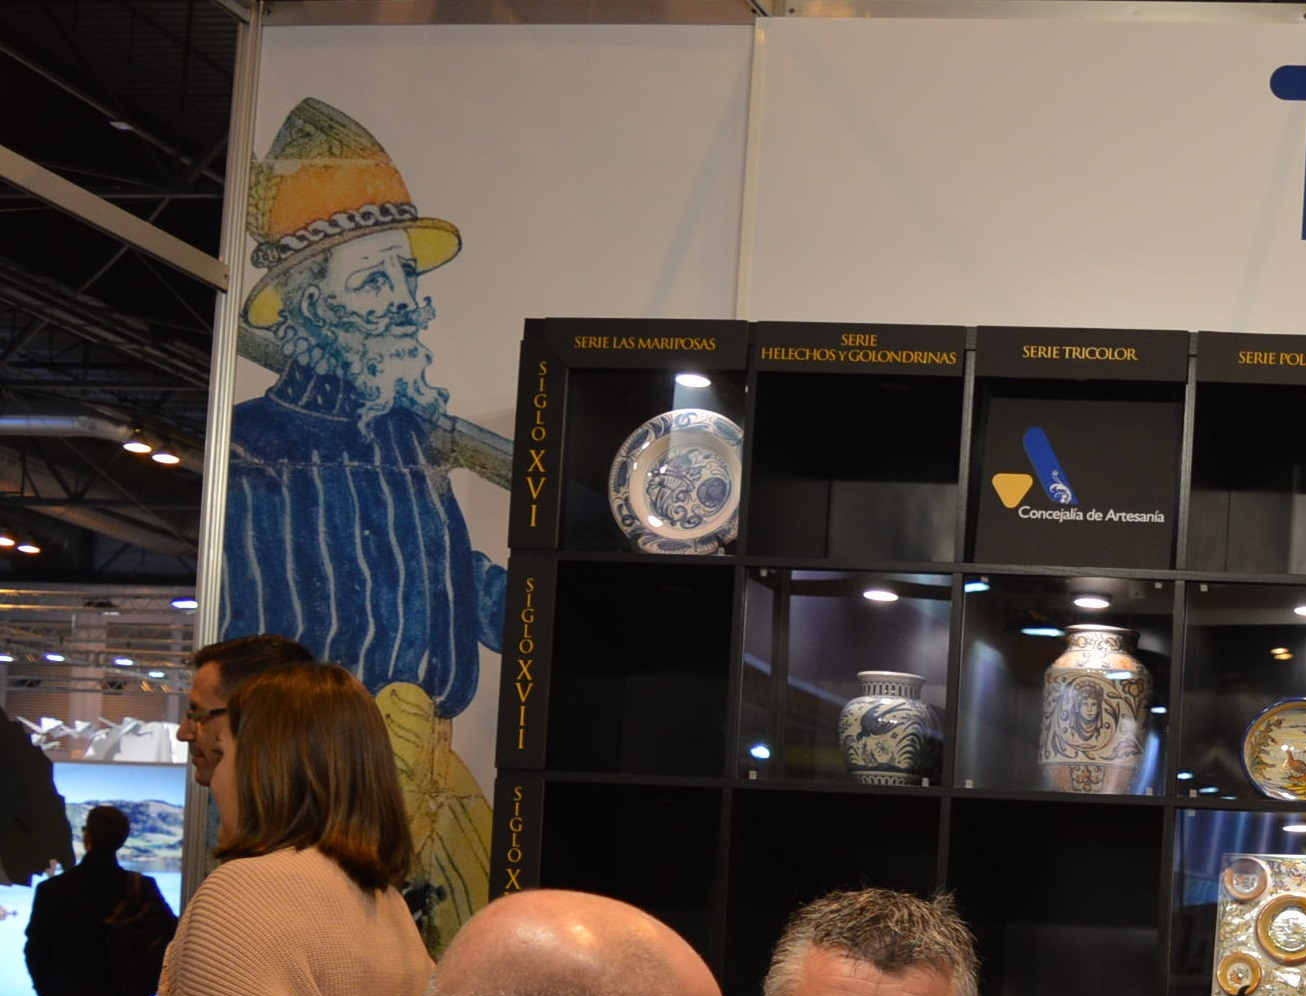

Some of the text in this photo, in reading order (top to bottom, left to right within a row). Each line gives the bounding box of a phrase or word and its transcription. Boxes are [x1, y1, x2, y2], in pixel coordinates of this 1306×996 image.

[574, 336, 716, 351] SERIE LAS MARIPOSAS
[841, 333, 878, 347] SERIE
[761, 347, 958, 365] HELECHOS Y GOLONDRINAS
[1022, 345, 1139, 362] SERIE TRICOLOR
[1238, 350, 1276, 366] SERIE
[525, 361, 548, 528] SIGLO XVI
[1017, 505, 1165, 524] Concejalía de Artesanía
[515, 577, 535, 749] SIGLO XVII
[507, 786, 522, 862] SIGLO
